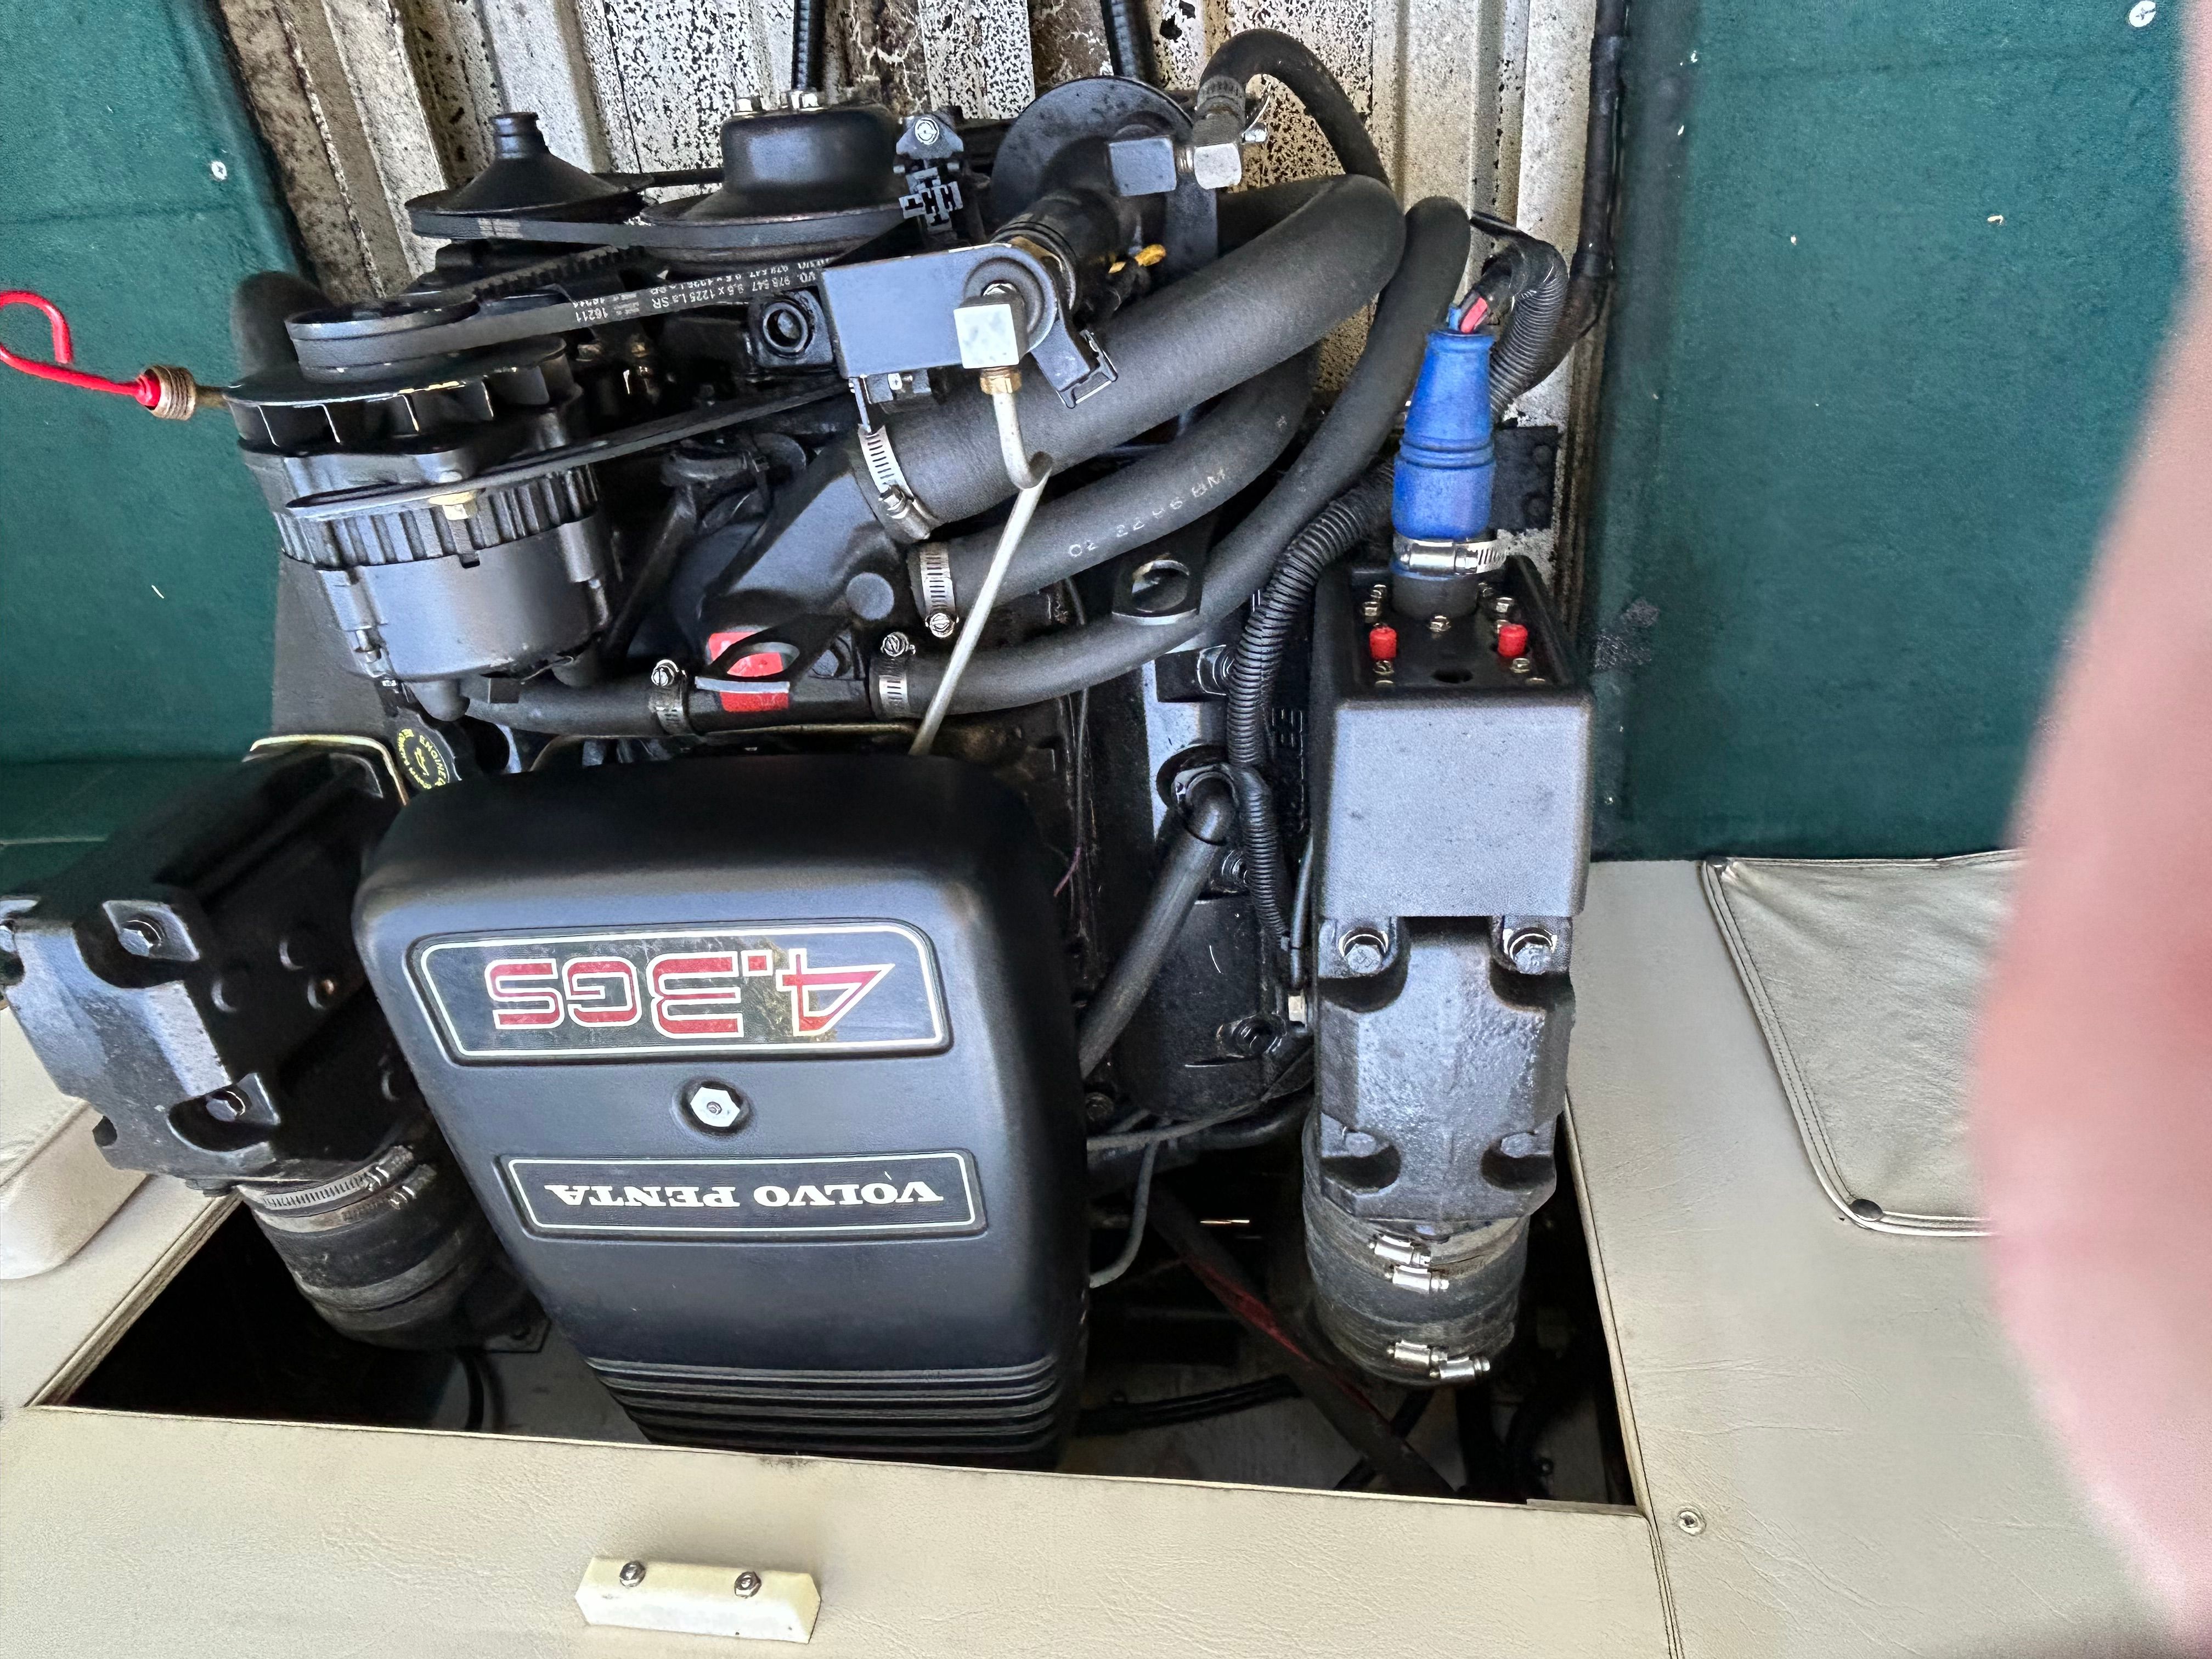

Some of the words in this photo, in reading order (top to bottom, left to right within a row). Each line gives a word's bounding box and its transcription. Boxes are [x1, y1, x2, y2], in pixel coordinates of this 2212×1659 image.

[651, 296, 670, 309] SR
[689, 289, 715, 303] 1225
[419, 735, 447, 779] ENGINE
[544, 1183, 740, 1209] PENTA
[753, 1180, 945, 1207] VOLVO
